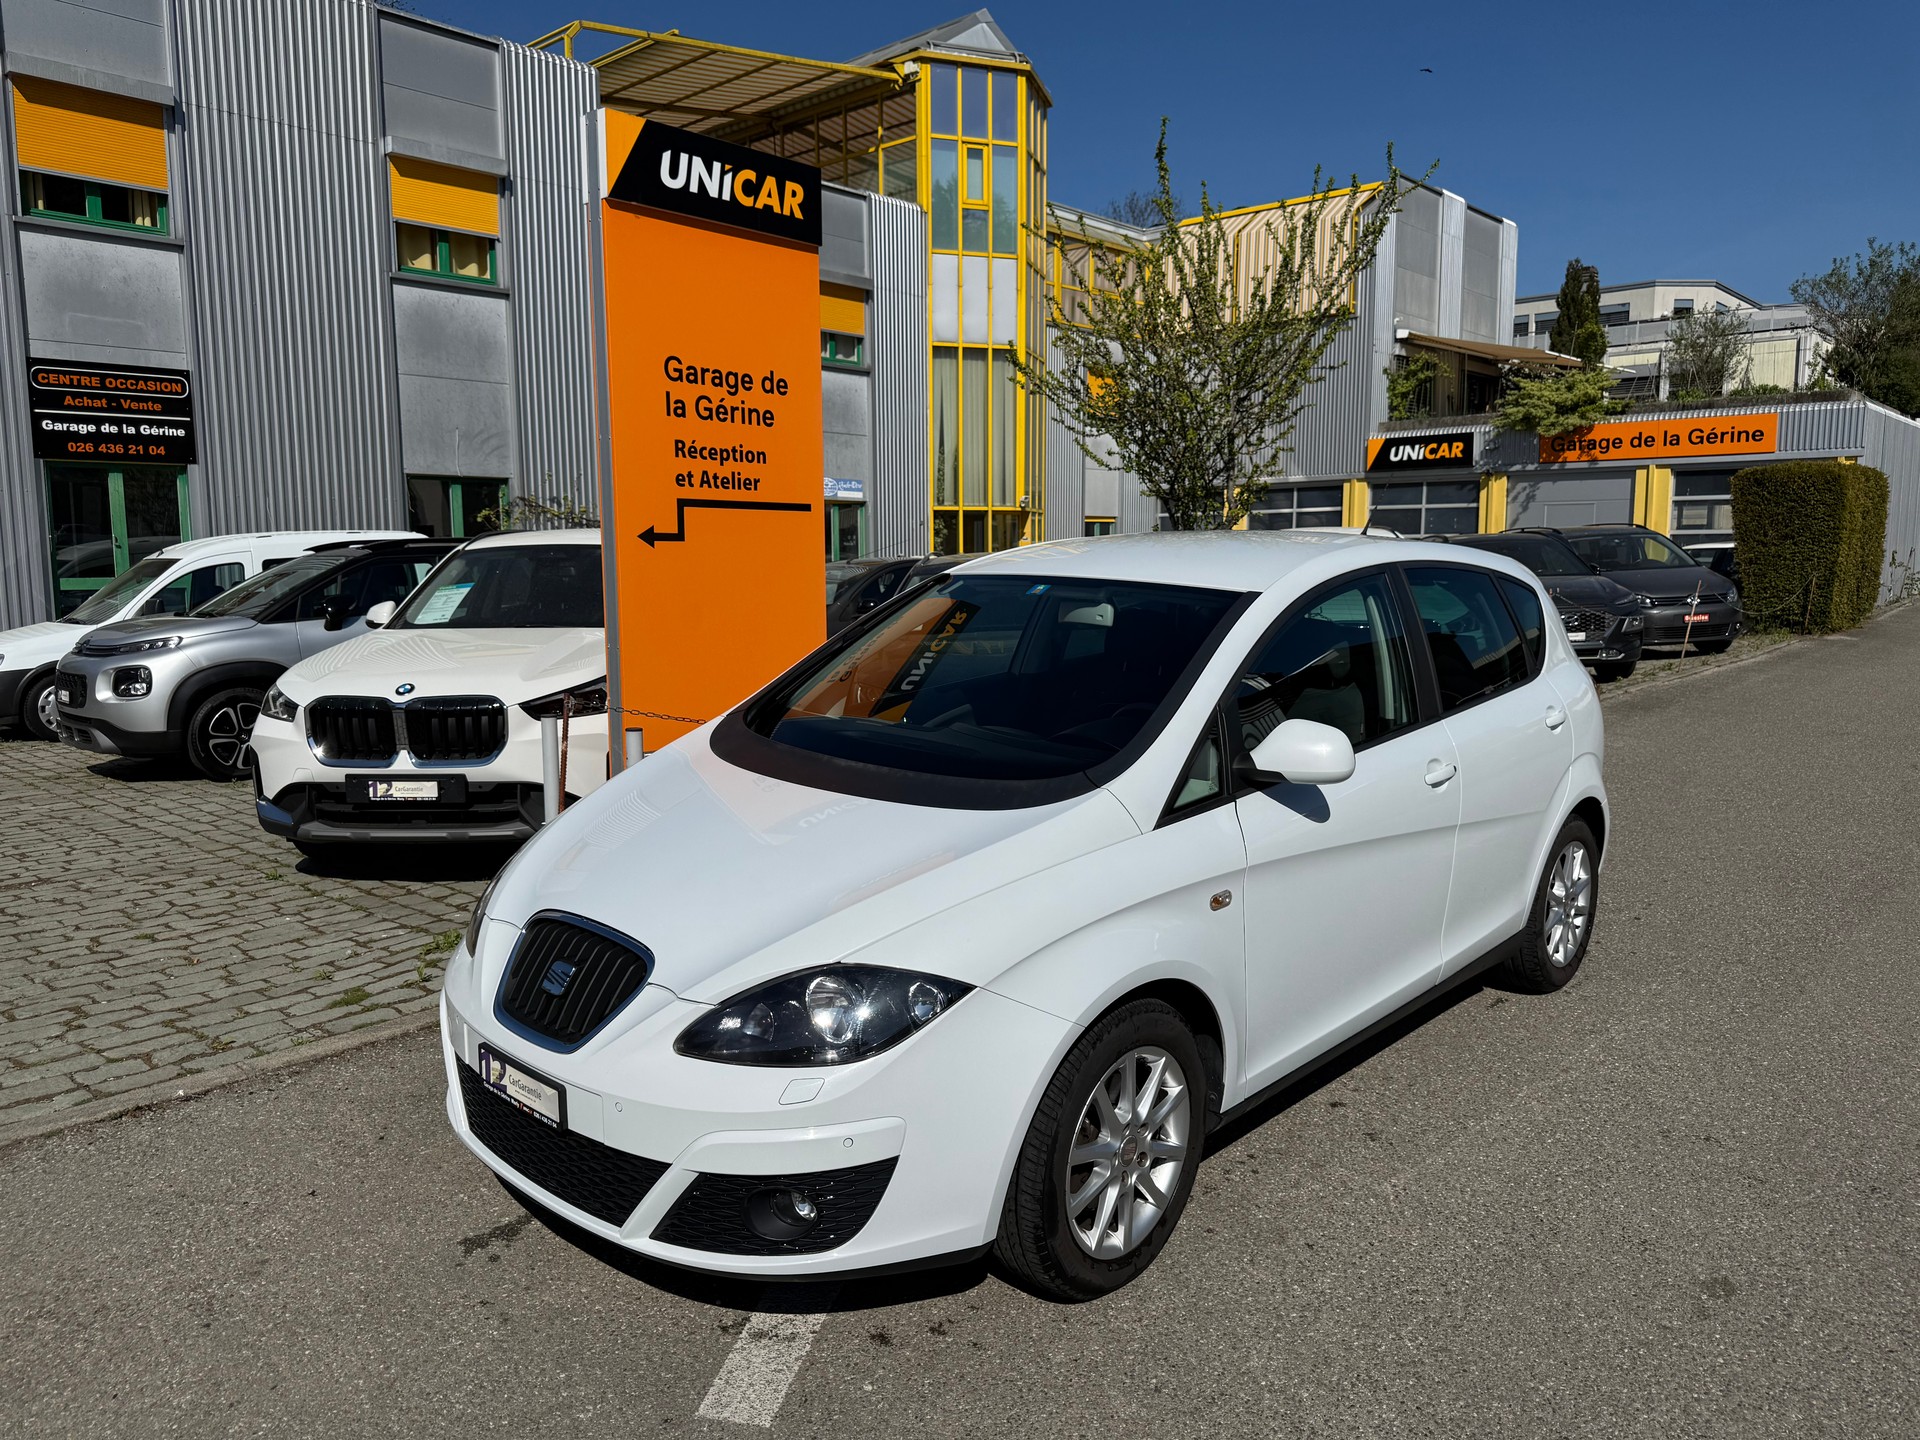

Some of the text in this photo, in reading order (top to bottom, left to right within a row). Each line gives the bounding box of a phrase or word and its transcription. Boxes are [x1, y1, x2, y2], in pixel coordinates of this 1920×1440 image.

[37, 373, 182, 393] CENTRE OCCASION
[664, 355, 789, 396] Garage de
[64, 395, 107, 408] Achat
[120, 399, 162, 411] Vente
[665, 391, 775, 428] la Gérine
[41, 420, 186, 437] Garage de la Gérine
[1551, 427, 1765, 454] Garage de la Gérine
[67, 442, 166, 456] 026 436 21 04
[674, 439, 767, 466] Réception
[675, 470, 760, 491] et Atelier
[508, 1074, 542, 1101] CarGarantie
